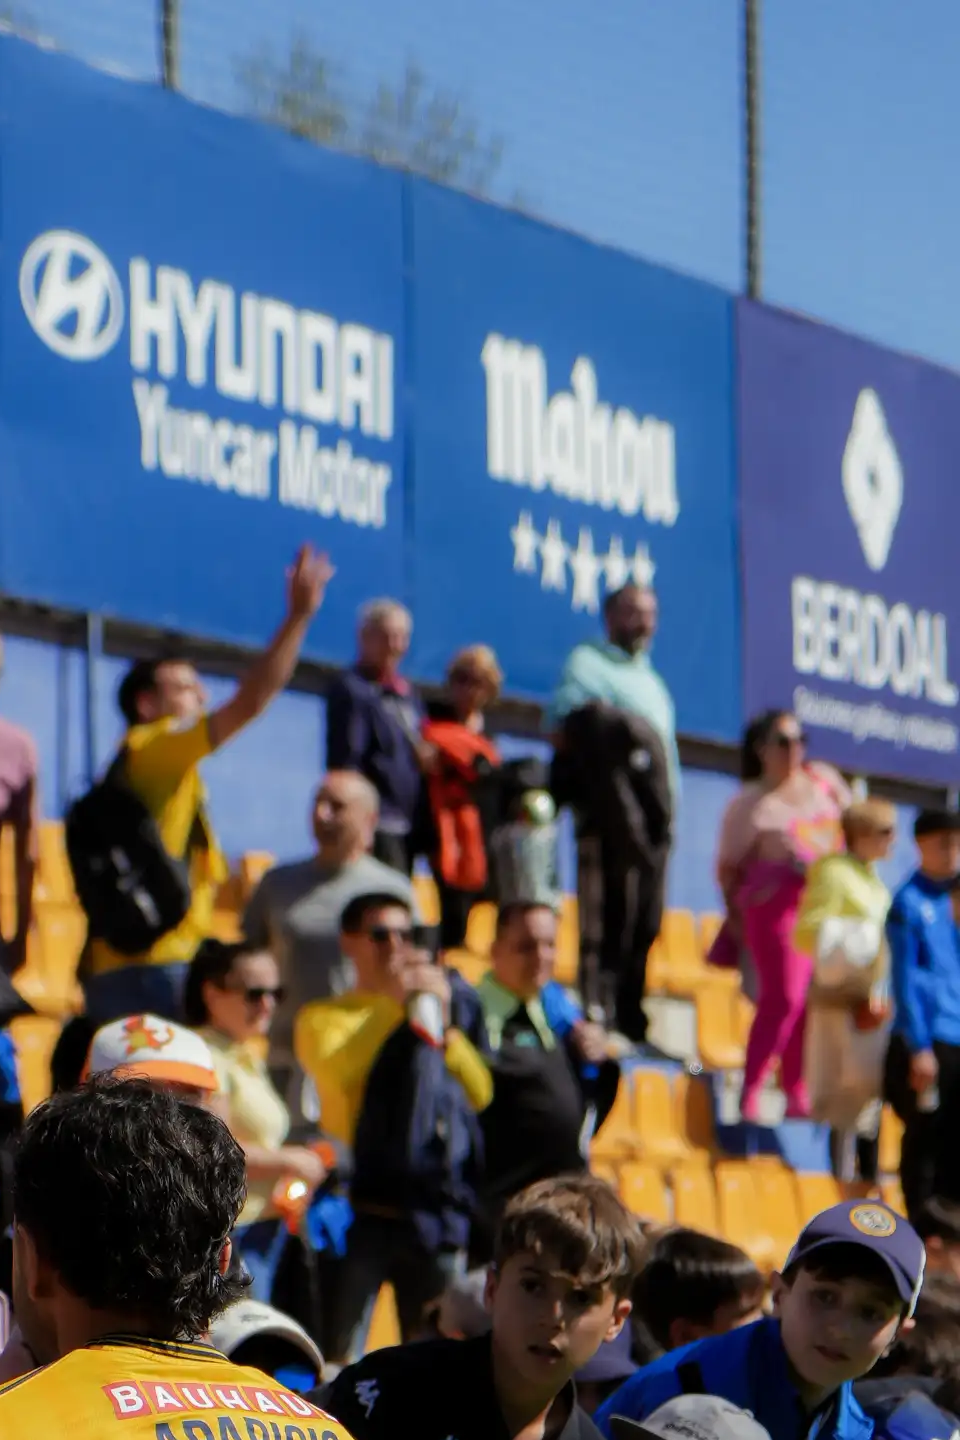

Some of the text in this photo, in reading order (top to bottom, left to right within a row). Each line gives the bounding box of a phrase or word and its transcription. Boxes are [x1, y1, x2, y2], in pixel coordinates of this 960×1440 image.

[129, 256, 394, 440] HYUNDAI
[481, 332, 680, 527] Mahou
[132, 377, 392, 529] Yuncar Motor
[792, 575, 959, 707] BERDOAL
